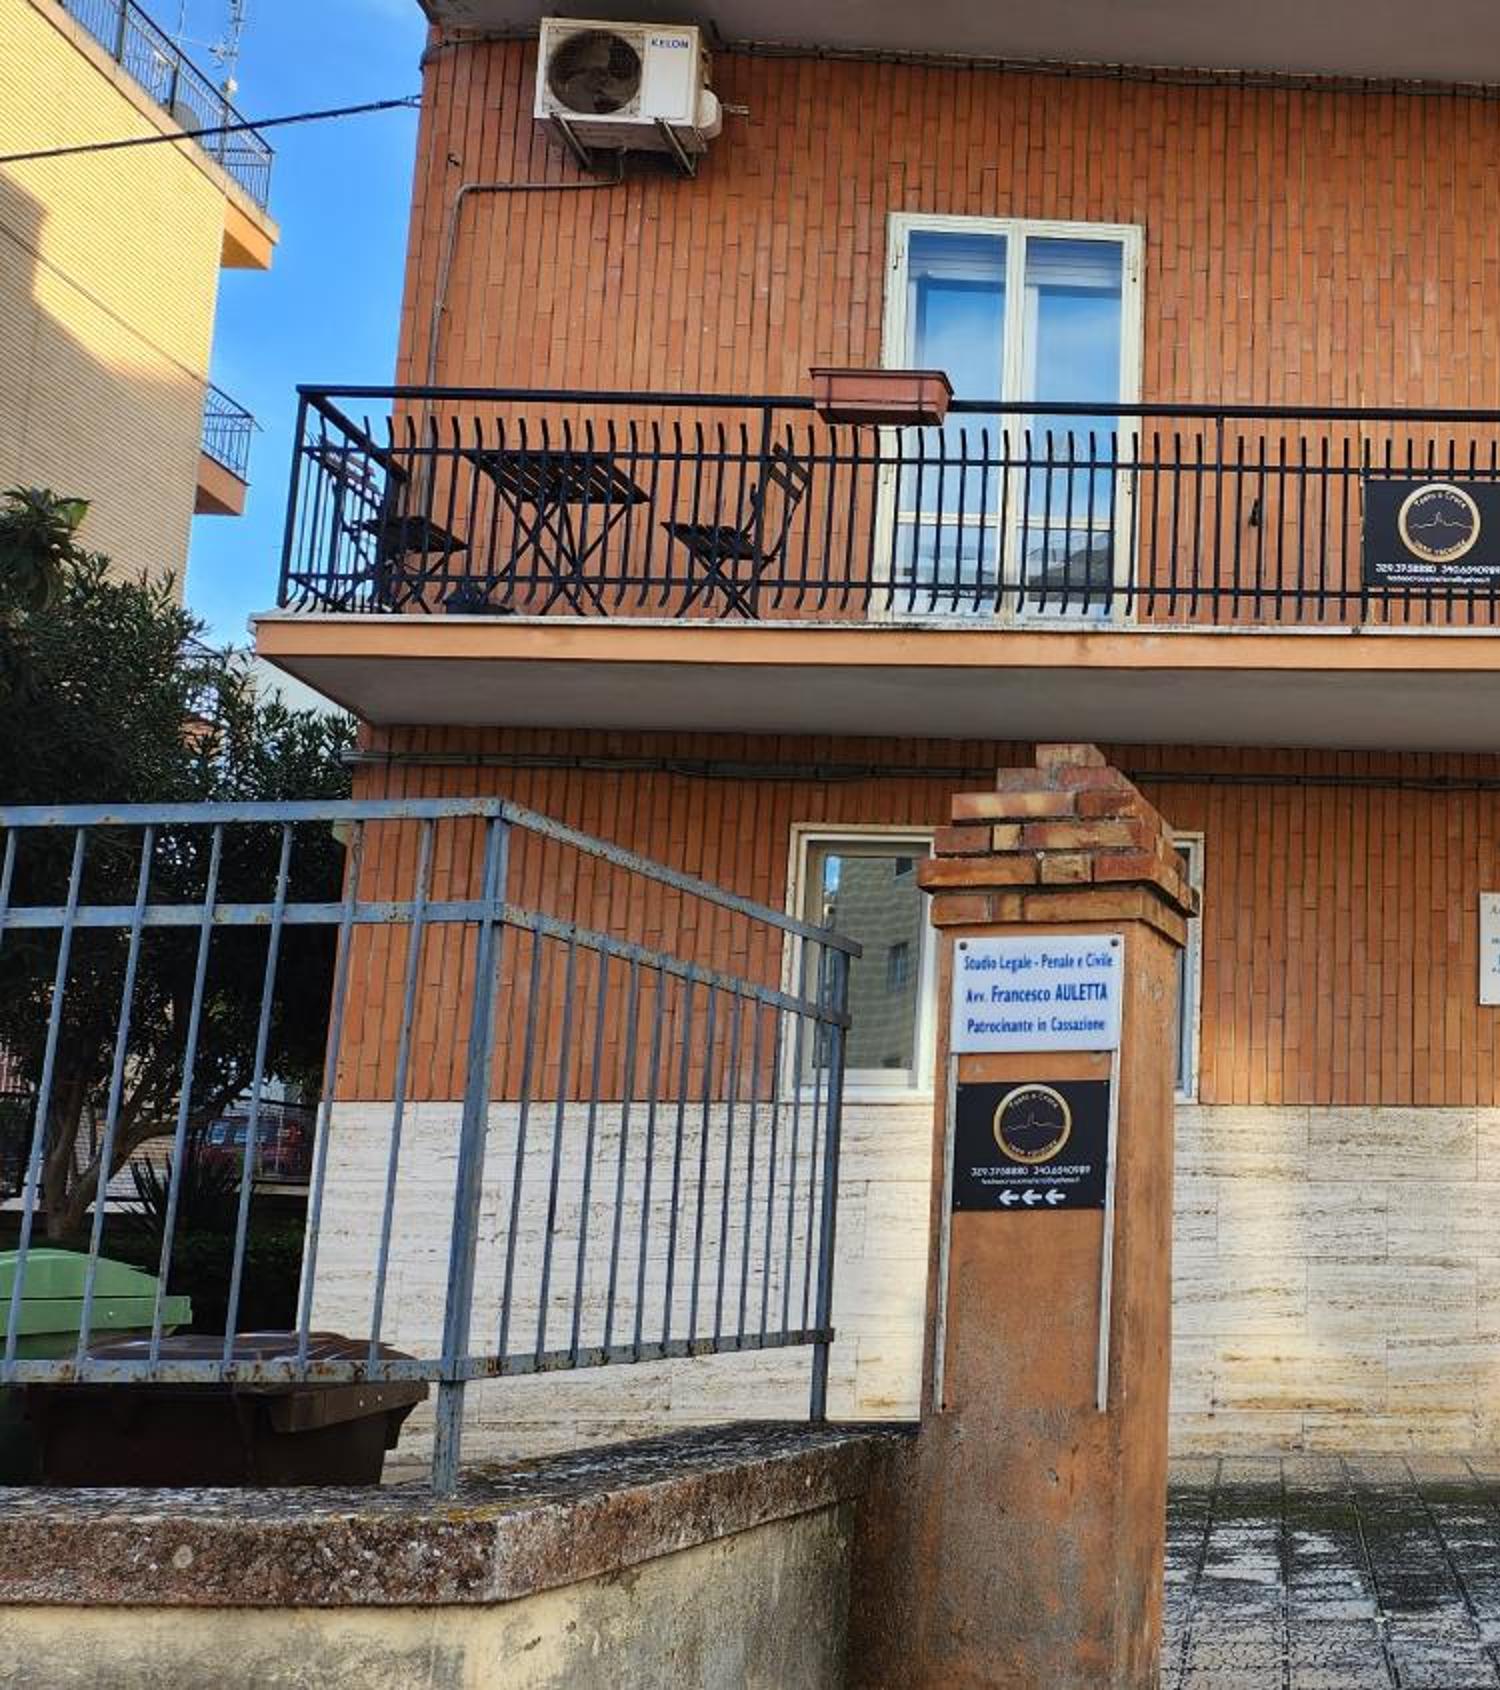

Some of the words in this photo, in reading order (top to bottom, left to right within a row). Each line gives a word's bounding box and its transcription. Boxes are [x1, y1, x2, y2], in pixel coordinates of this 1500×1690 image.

[651, 38, 689, 49] KELON
[964, 955, 996, 970] Studio
[1000, 954, 1032, 973] Legale
[1042, 953, 1074, 968] Penale
[1077, 958, 1083, 967] e
[1085, 952, 1113, 967] Civile
[991, 985, 1050, 1002] Francesco
[1055, 983, 1107, 1000] AULETTA
[967, 1017, 1033, 1033] Patrocinante
[1037, 1017, 1047, 1031] in
[1051, 1016, 1105, 1031] Cassazione
